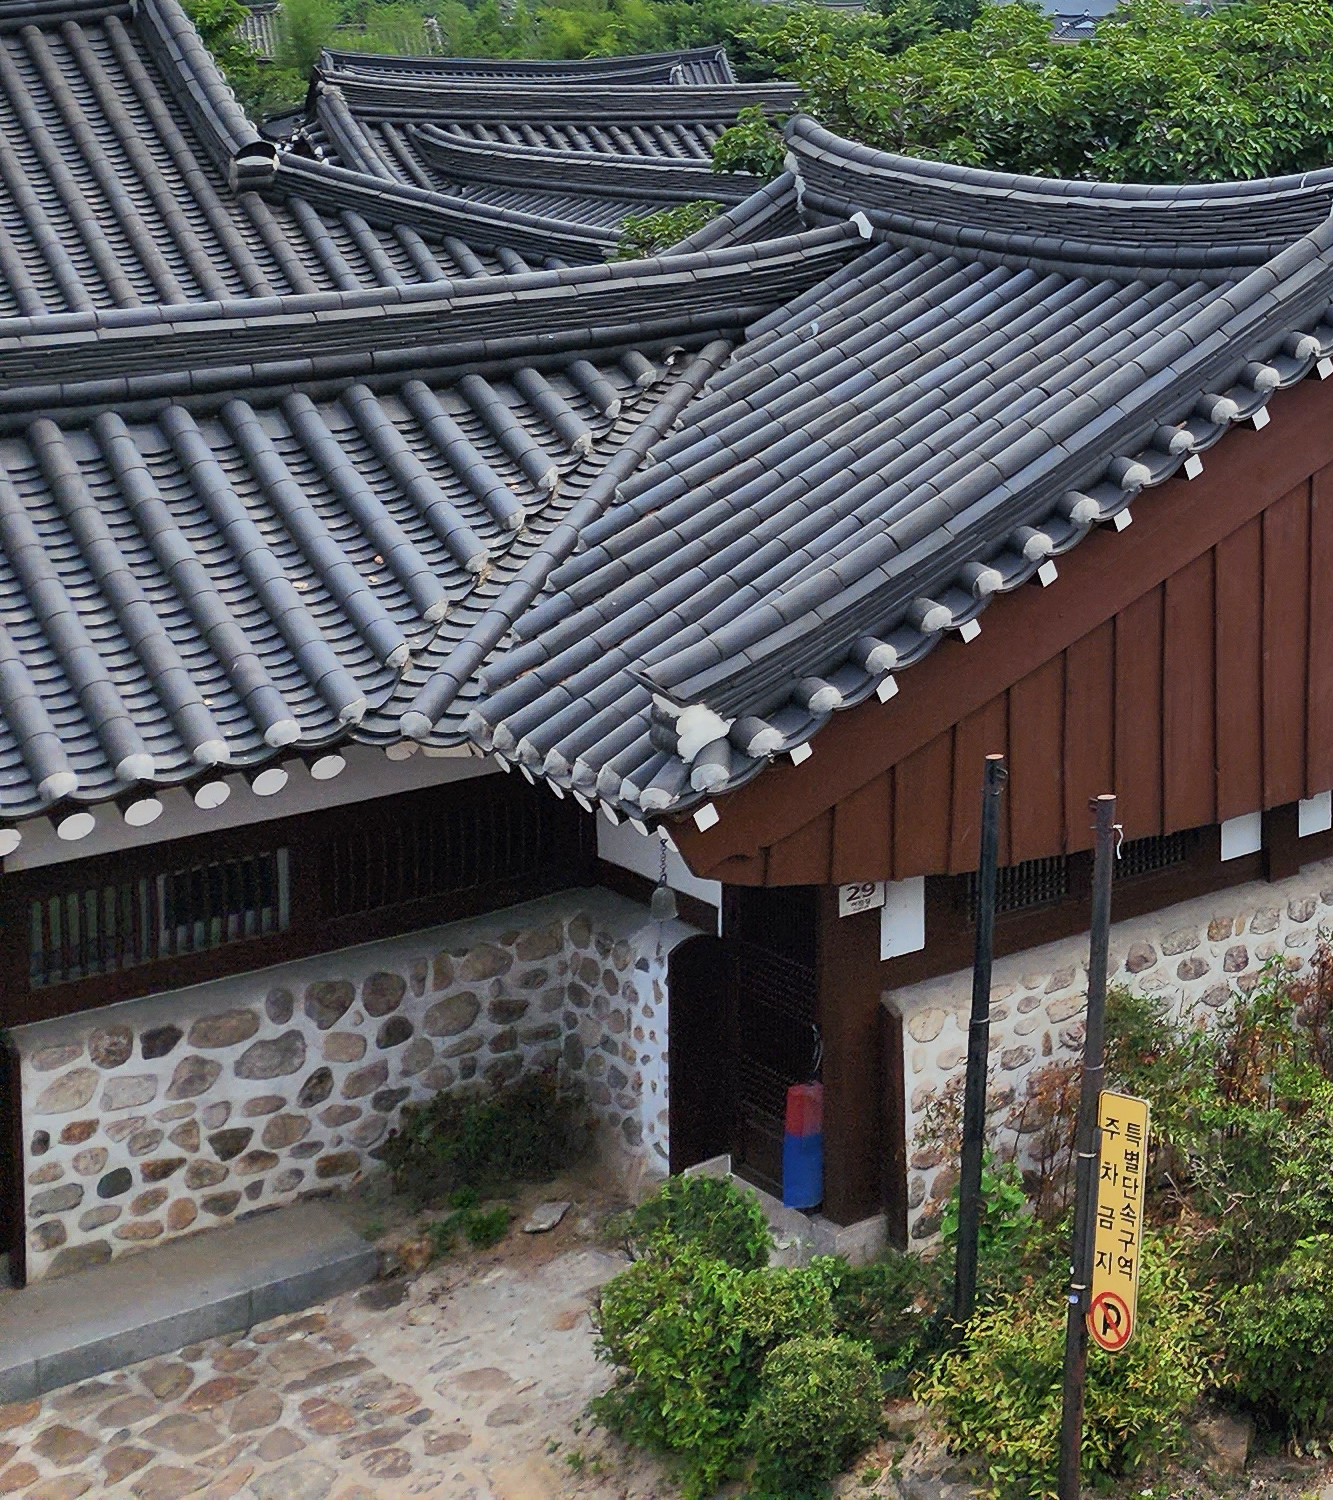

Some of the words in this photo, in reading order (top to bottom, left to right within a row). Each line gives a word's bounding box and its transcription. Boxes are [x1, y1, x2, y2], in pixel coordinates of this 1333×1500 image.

[846, 882, 876, 902] 29
[1096, 1117, 1121, 1275] 주차금지
[1117, 1122, 1142, 1281] 특별단속구역
